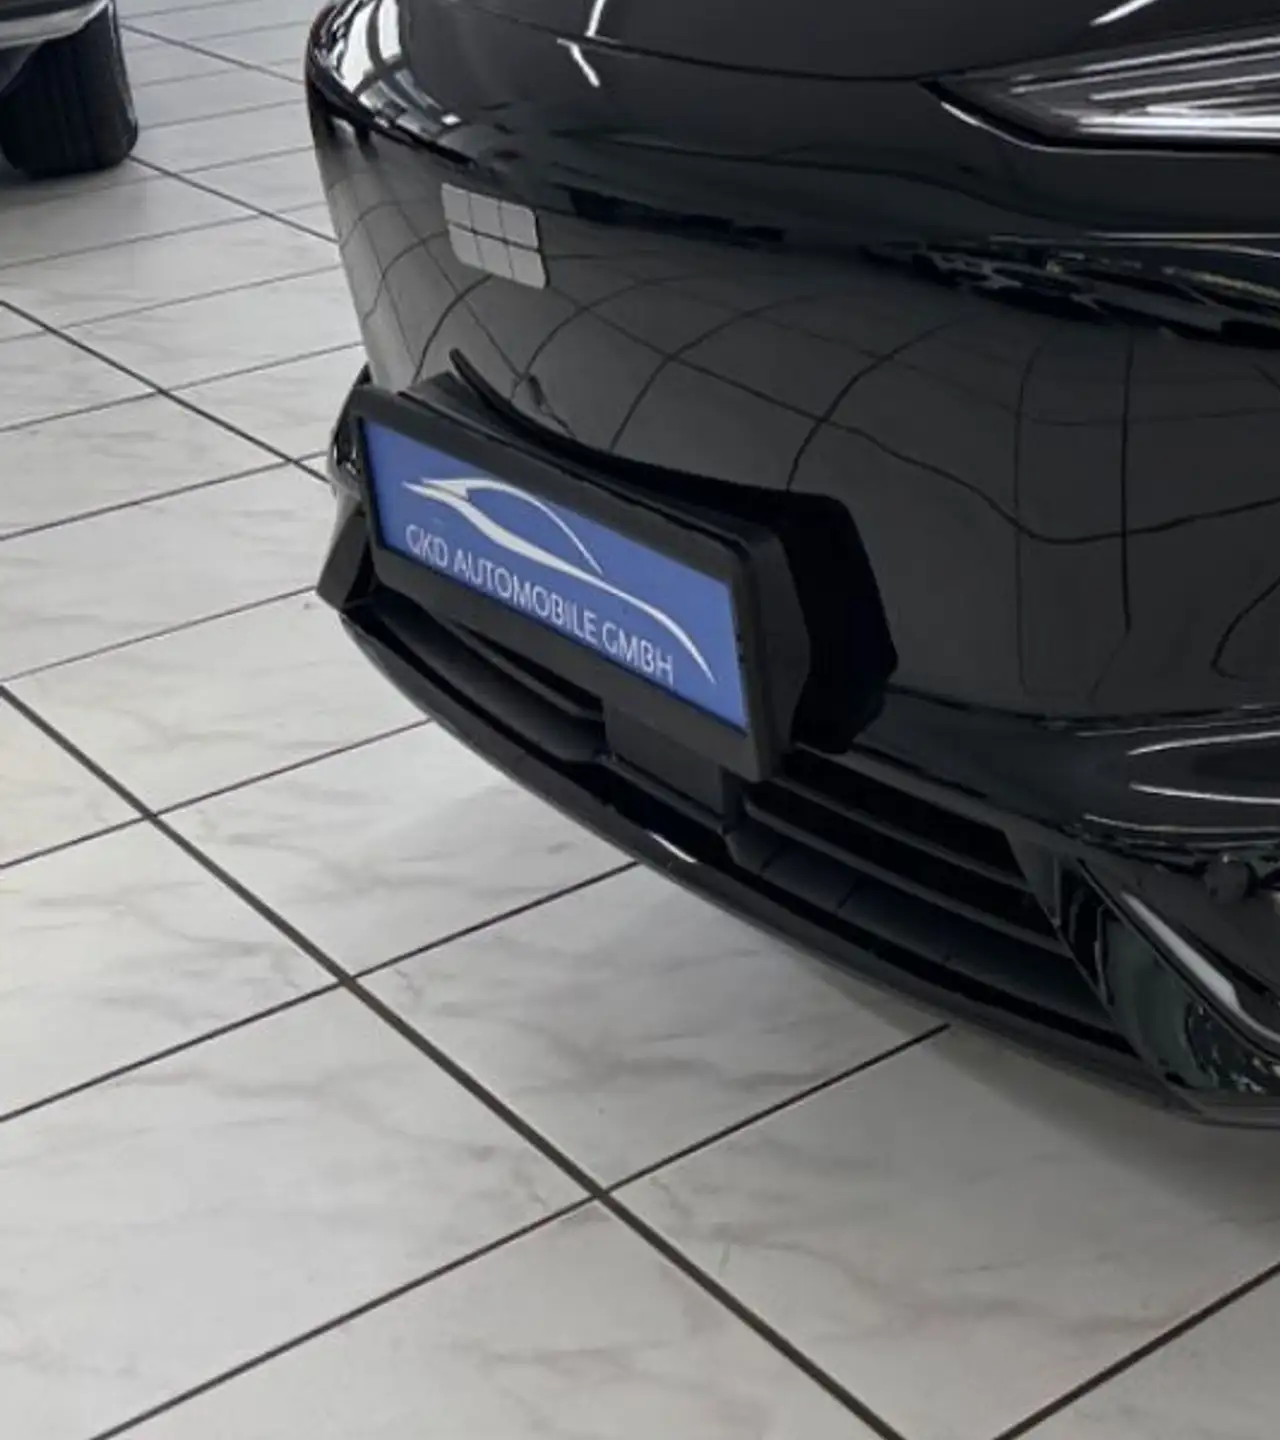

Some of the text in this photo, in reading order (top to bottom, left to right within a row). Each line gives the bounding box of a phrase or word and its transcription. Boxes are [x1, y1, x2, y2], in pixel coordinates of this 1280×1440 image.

[405, 523, 674, 685] GKD AUTOMOBILE GMBH
